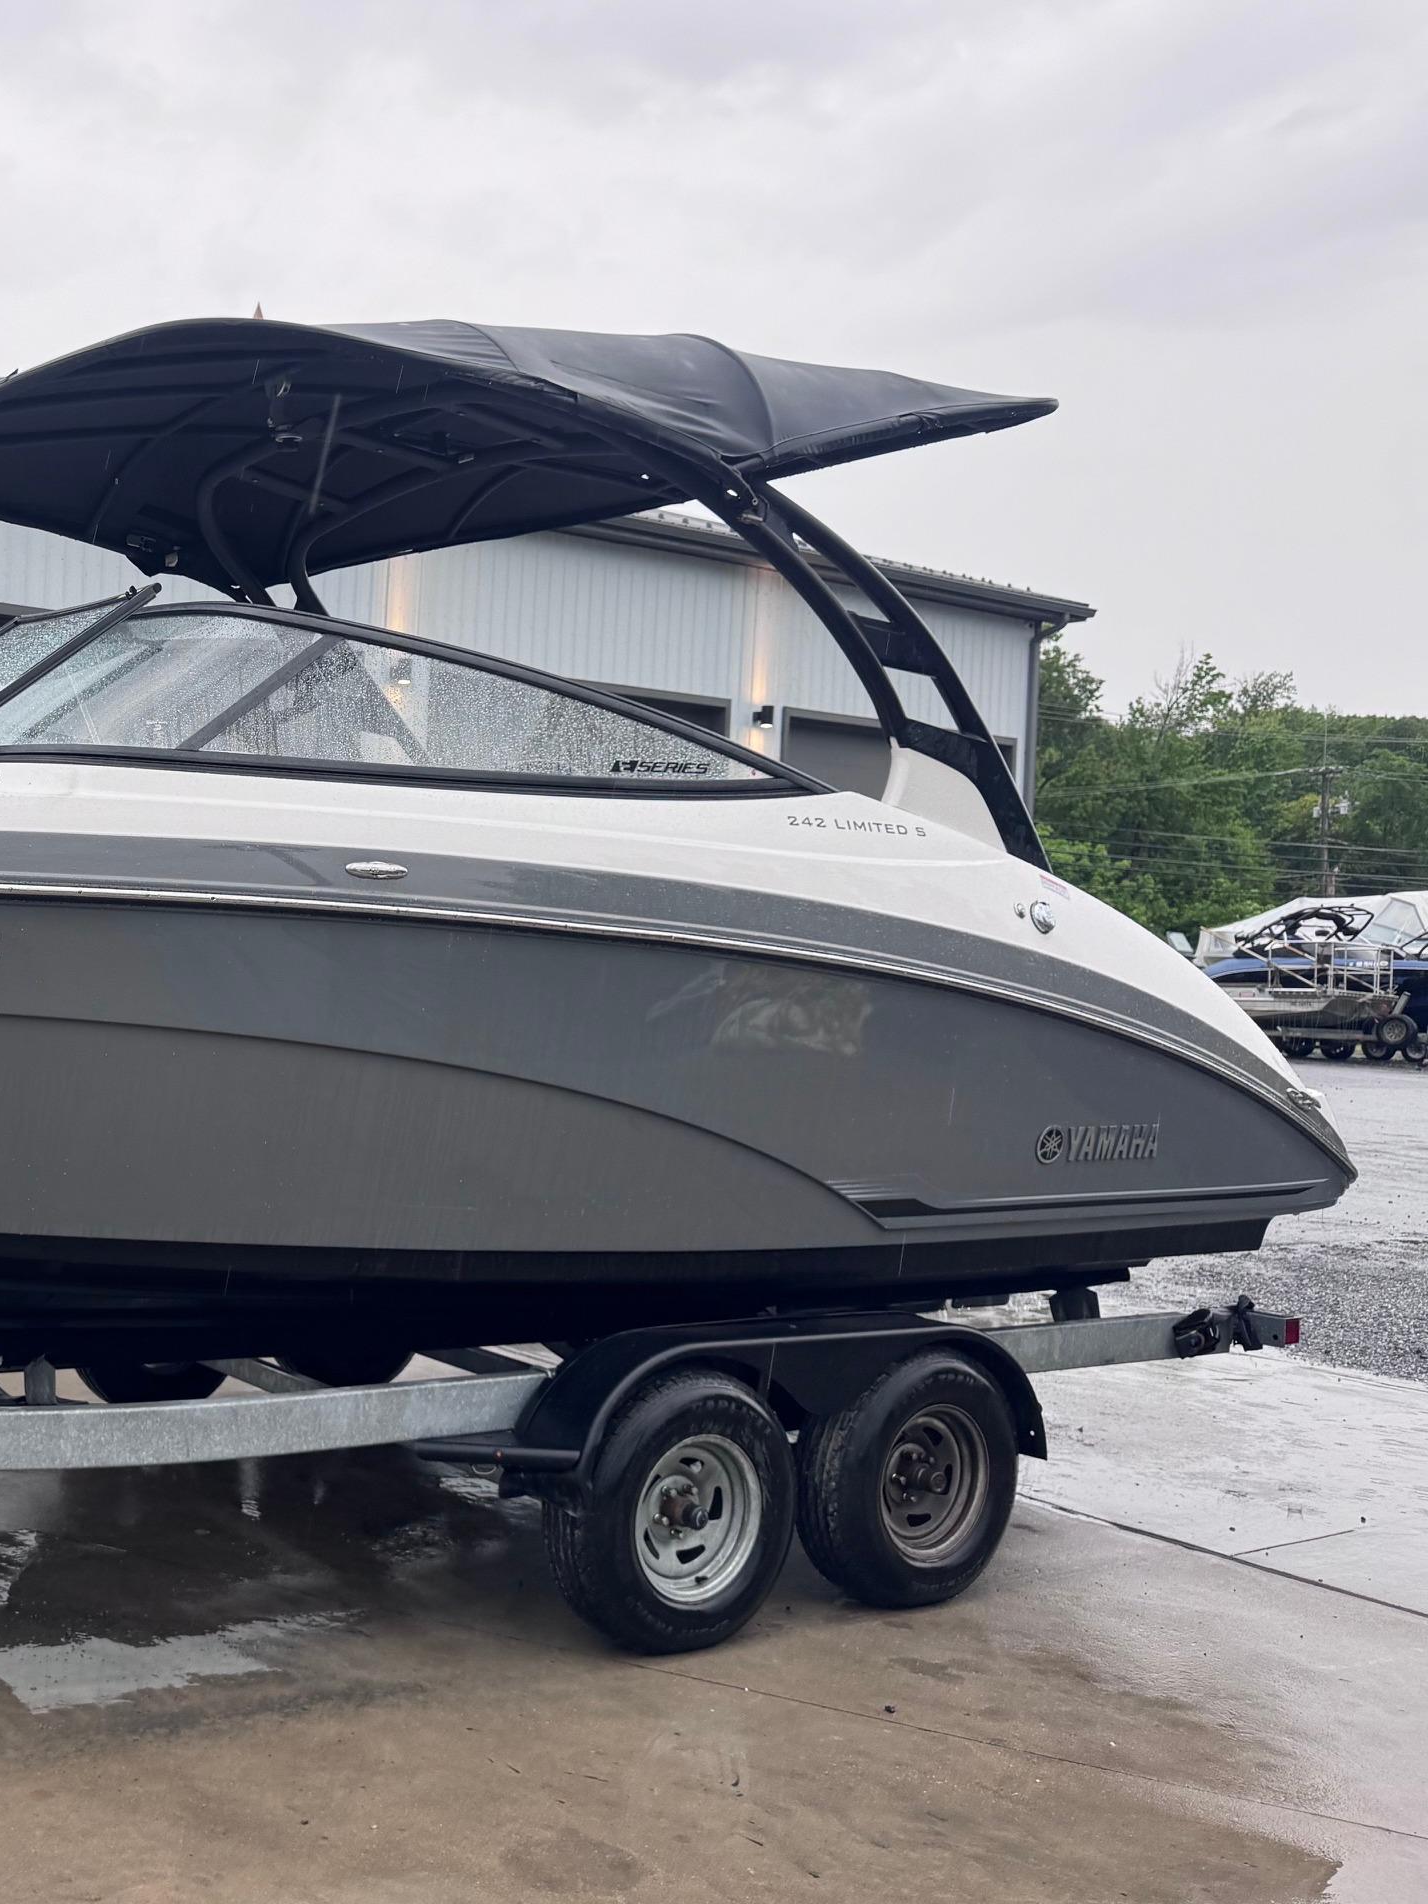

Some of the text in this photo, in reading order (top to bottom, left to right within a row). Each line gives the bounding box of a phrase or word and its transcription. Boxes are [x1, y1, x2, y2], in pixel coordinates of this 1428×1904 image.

[637, 761, 710, 774] SERIES
[787, 816, 926, 837] 242 LIMITED S
[1068, 1124, 1160, 1161] YAMAHA
